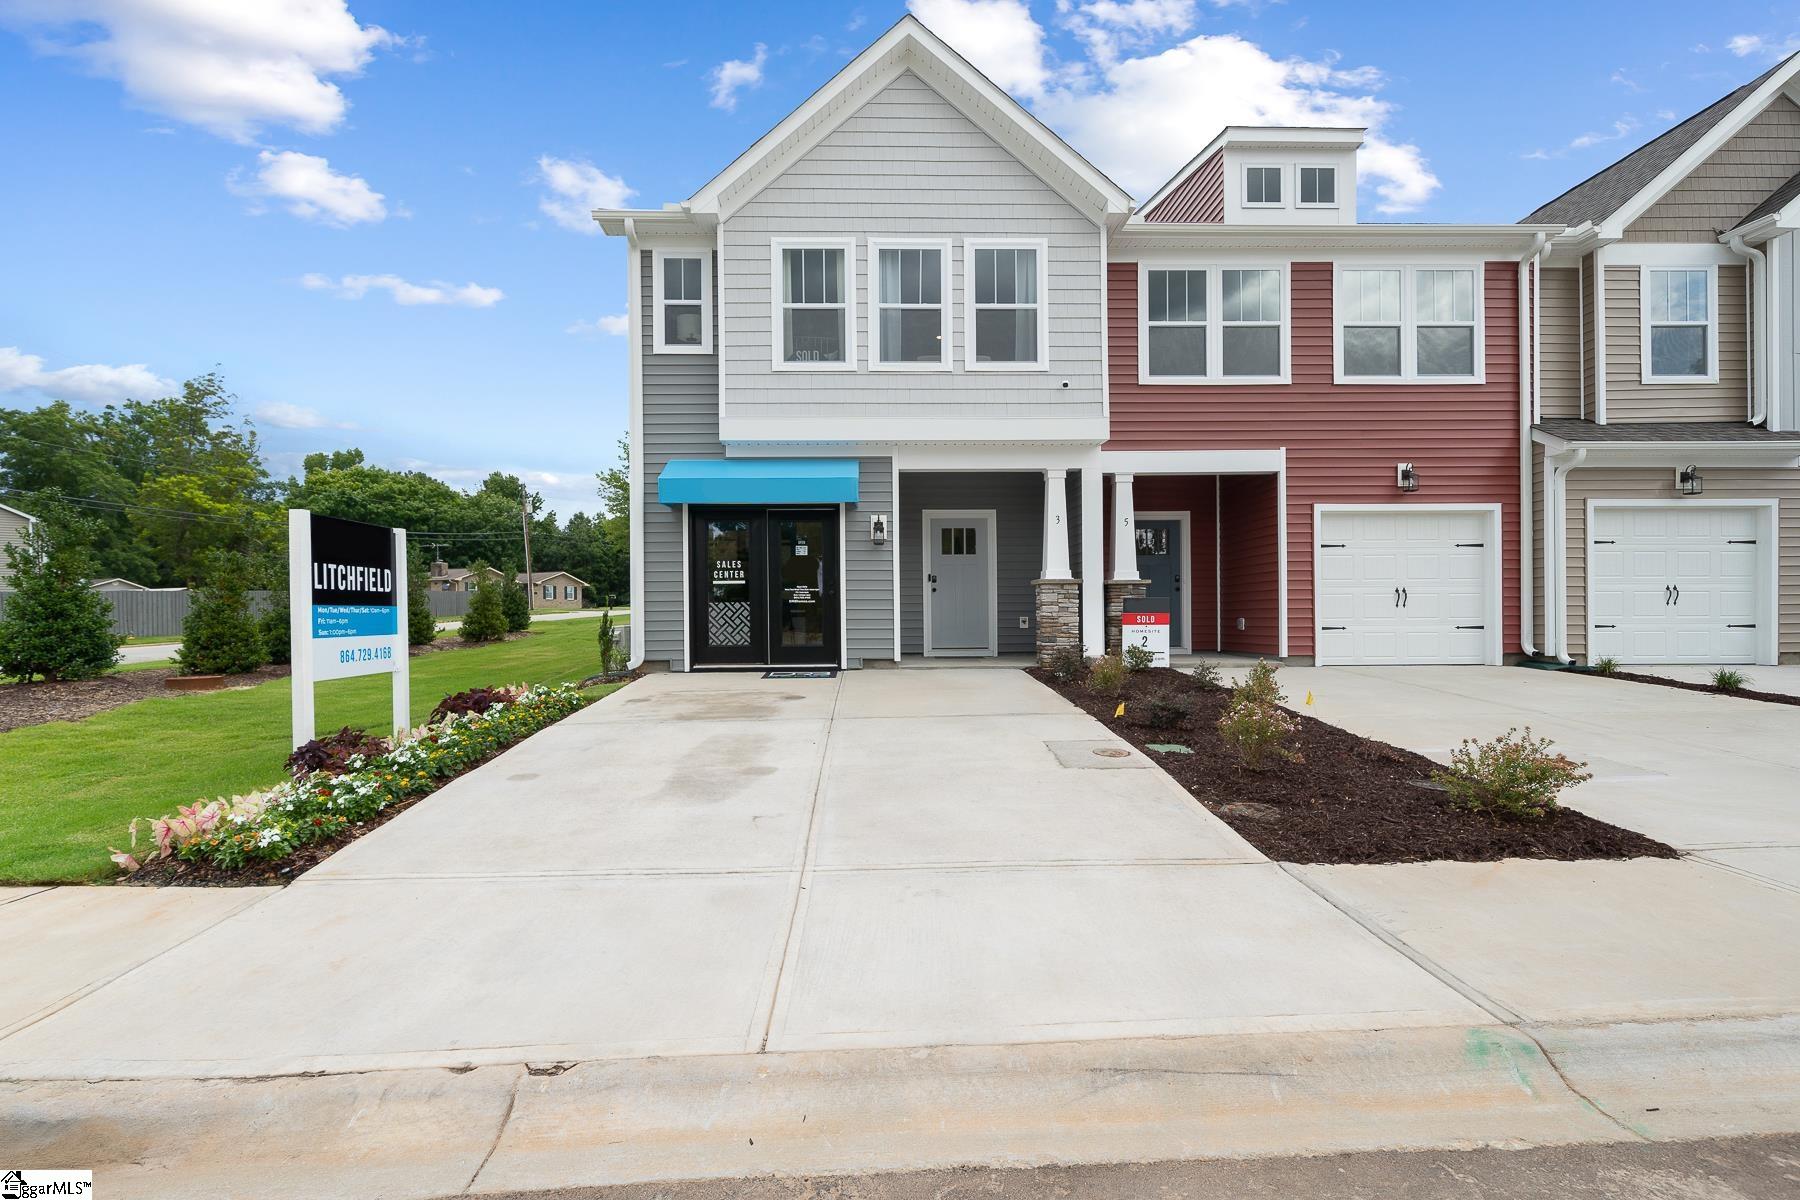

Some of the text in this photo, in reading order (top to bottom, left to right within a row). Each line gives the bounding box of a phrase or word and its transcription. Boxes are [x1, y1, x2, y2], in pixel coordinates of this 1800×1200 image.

[796, 350, 819, 361] SOLD
[1055, 515, 1061, 525] 3
[1124, 517, 1129, 527] 5
[716, 560, 742, 568] SALES
[314, 562, 391, 592] LITCHFIELD
[713, 570, 744, 578] CENTER
[1136, 615, 1155, 623] SOLD
[1142, 635, 1148, 648] 2
[340, 646, 391, 663] 864.729.4168
